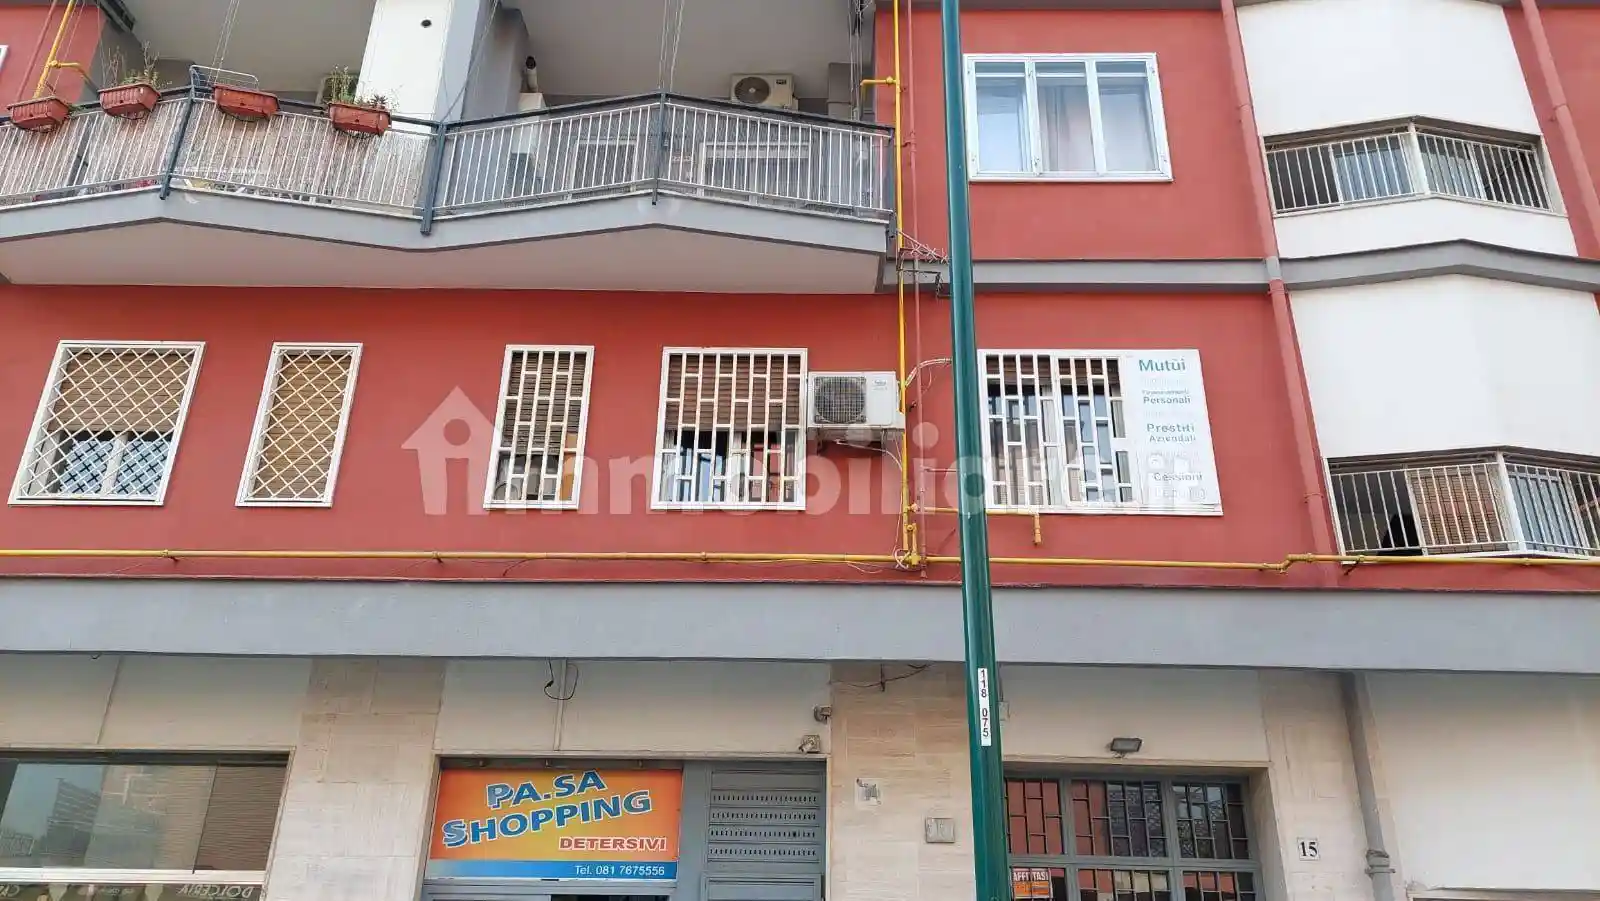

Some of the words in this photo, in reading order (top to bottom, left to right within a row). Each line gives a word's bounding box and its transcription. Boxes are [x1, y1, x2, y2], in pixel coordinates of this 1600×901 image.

[1142, 395, 1191, 405] Personali
[981, 707, 989, 738] 075
[486, 769, 607, 811] PA.SA
[442, 790, 652, 847] SHOPPING
[558, 836, 668, 851] DETERSIVI
[1300, 841, 1318, 857] 15
[575, 865, 593, 875] Tel.
[595, 865, 615, 875] 081
[619, 865, 665, 876] 7675556
